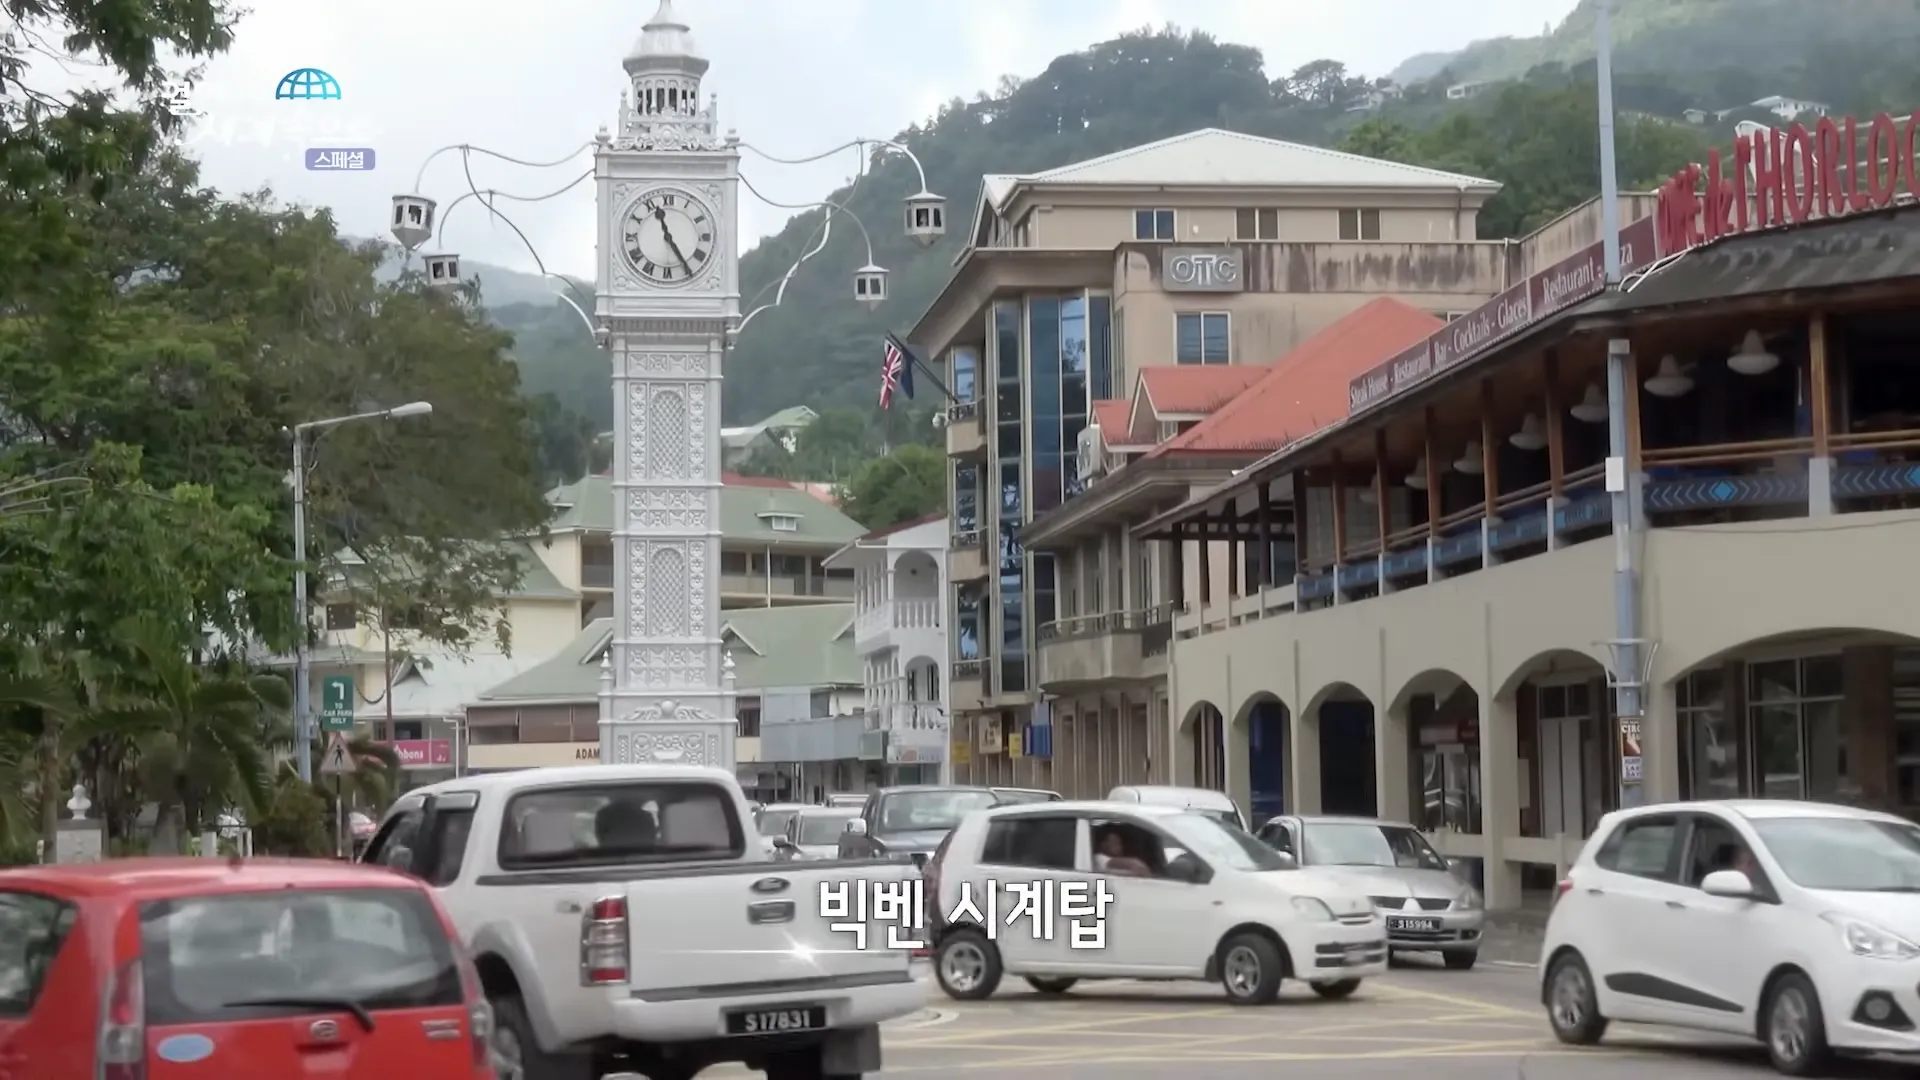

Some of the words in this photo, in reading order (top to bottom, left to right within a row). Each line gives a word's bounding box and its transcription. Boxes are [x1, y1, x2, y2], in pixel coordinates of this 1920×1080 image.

[1169, 253, 1237, 286] OTC
[1542, 256, 1595, 305] Restaurant
[1452, 315, 1491, 354] Cocktails
[745, 1009, 811, 1032] S17831
